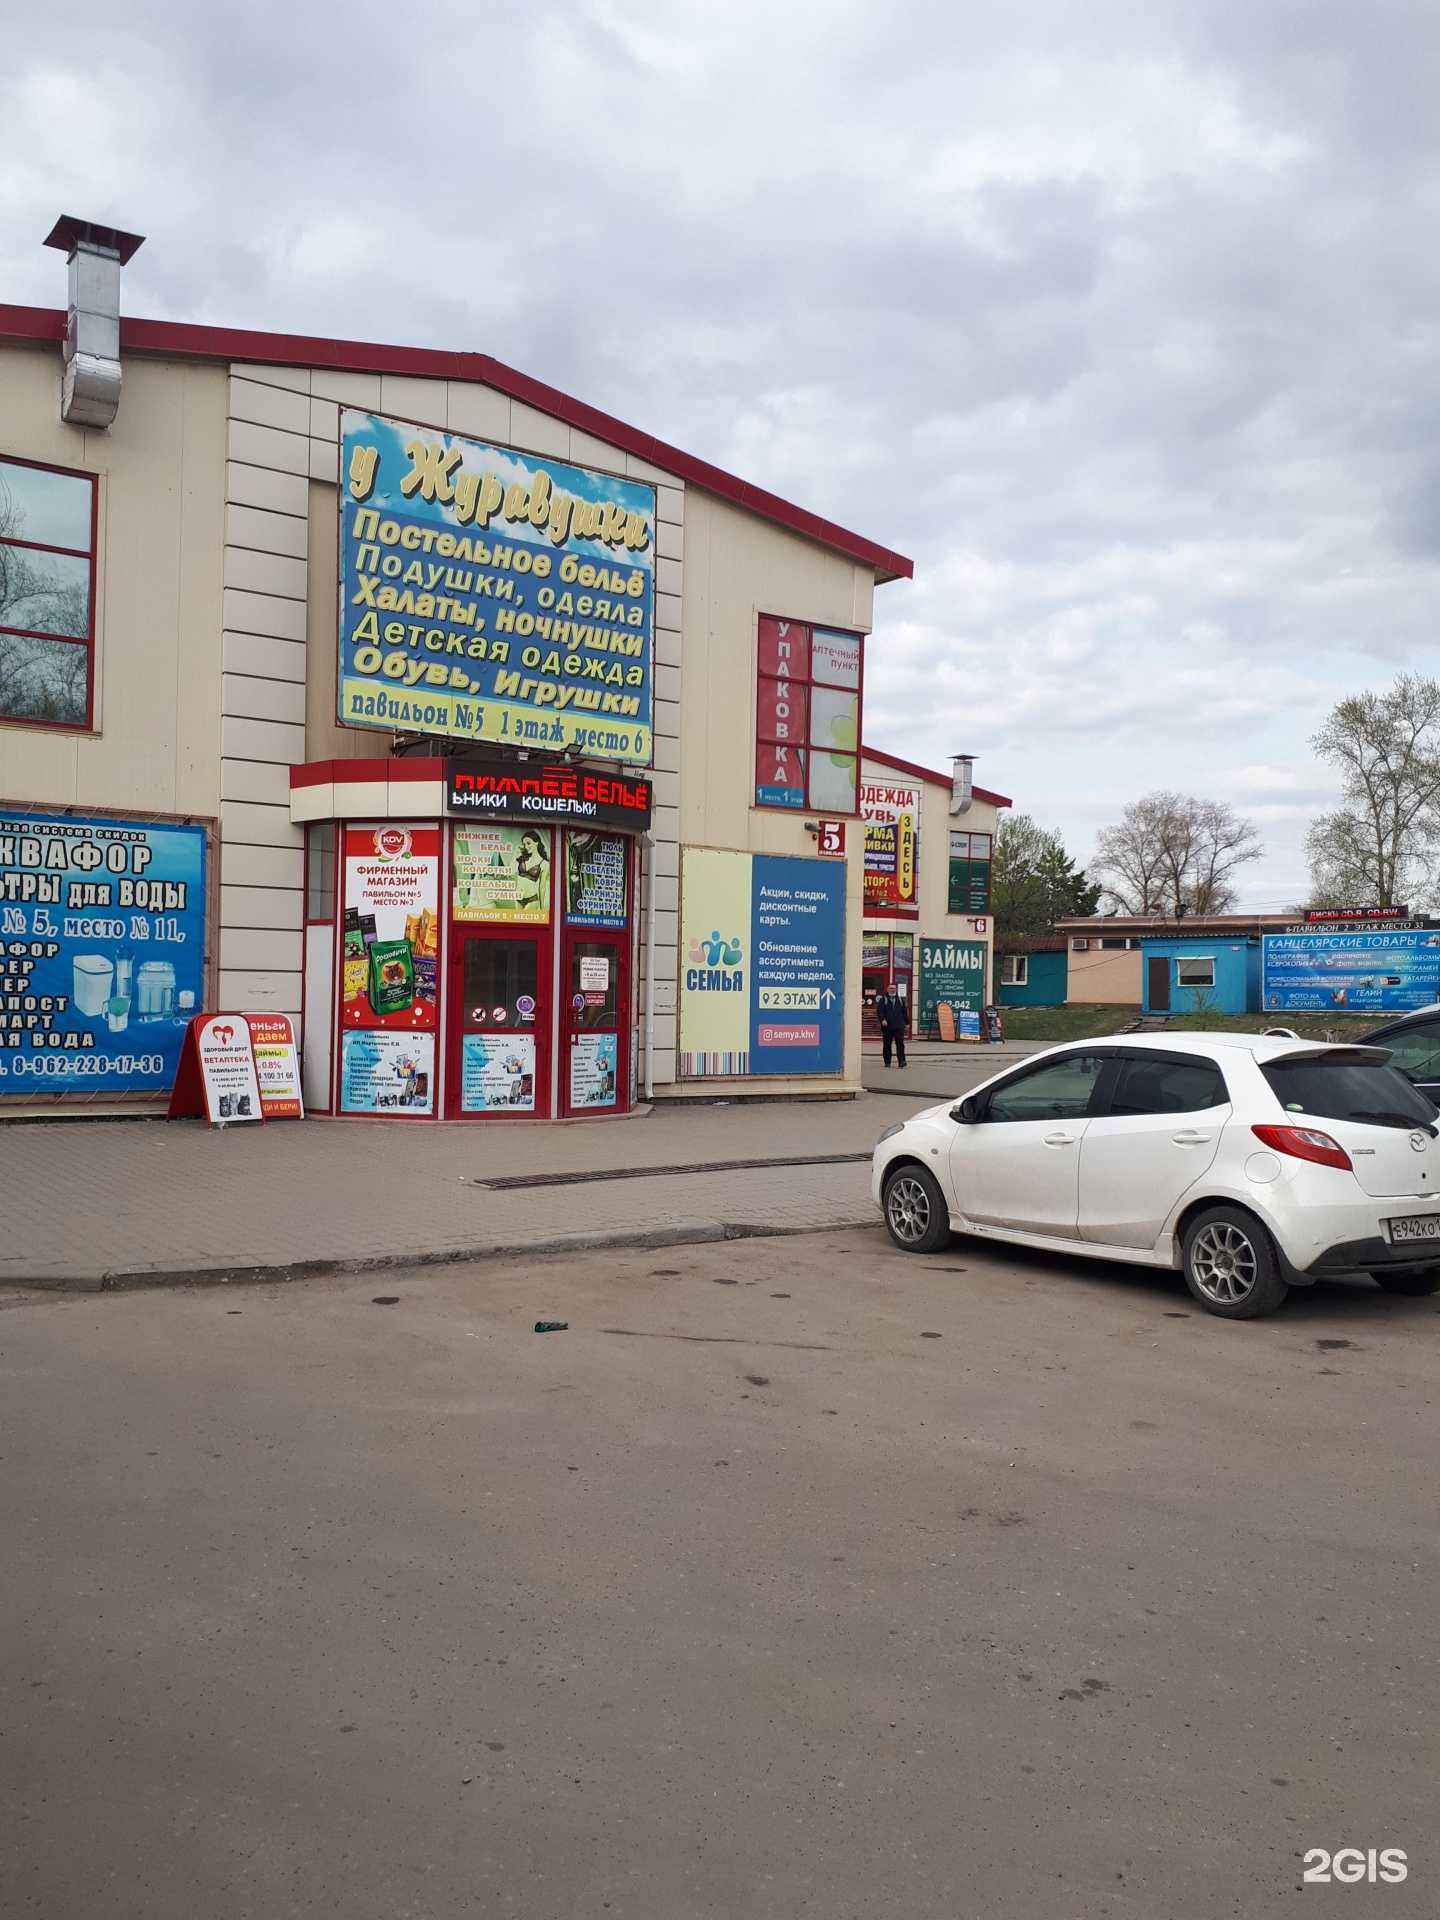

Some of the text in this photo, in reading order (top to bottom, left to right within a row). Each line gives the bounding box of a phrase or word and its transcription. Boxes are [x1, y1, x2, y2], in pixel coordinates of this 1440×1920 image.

[400, 440, 650, 547] Журавушки
[353, 507, 645, 599] Постельное бельё
[355, 543, 644, 628] Подушки, одеяла
[352, 574, 645, 657] Халаты, ночнушки
[352, 611, 644, 687] Детская одежда
[353, 646, 642, 718] Обувь, Игрушки
[774, 621, 792, 783] УПАКОВКА
[351, 692, 449, 727] павильон
[501, 710, 509, 736] 1
[514, 716, 565, 744] этаж
[574, 726, 630, 753] место
[634, 730, 644, 754] 6
[583, 775, 648, 810] БЕЛЬЁ
[521, 795, 598, 815] КОШЕЛЬКИ
[860, 807, 896, 823] УВЬ
[0, 821, 147, 842] кая система скидок
[456, 831, 501, 841] НИЖНЕЕ
[823, 823, 840, 850] 5
[601, 840, 624, 852] ТЮЛЬ
[902, 816, 911, 889] ЗДЕСЬ
[456, 855, 491, 863] НОСКИ
[593, 852, 624, 864] ШТОРЫ
[357, 864, 428, 875] ФИРМЕННЫЙ
[463, 865, 512, 874] КОЛГОТКИ
[581, 864, 624, 876] ГОБЕЛЕНЫ
[367, 877, 417, 886] МАГАЗИН
[458, 880, 515, 889] КОШЕЛЬКИ
[595, 877, 624, 888] КОВРЫ
[68, 881, 112, 909] для
[119, 878, 188, 914] ВОДЫ
[362, 890, 406, 898] ПАВИЛЬОН
[487, 891, 522, 899] СУМКИ
[584, 888, 624, 900] КАРНИЗЫ
[759, 885, 829, 901] Акции, скидки,
[577, 899, 624, 911] ФУРНИТУРА
[759, 901, 817, 913] дисконтные
[63, 916, 126, 939] место
[759, 914, 792, 927] карты.
[976, 918, 985, 932] 6
[1354, 923, 1379, 931] ЭТАЖ
[1381, 921, 1411, 931] МЕСТО
[759, 941, 818, 954] Обновление
[1268, 935, 1417, 949] КАНЦЕЛЯРСКИЕ ТОВАРЫ
[758, 956, 825, 969] ассортимента
[922, 944, 983, 970] ЗАЙМЫ
[0, 959, 36, 975] ЕР
[686, 968, 743, 992] СЕМЬЯ
[758, 970, 836, 982] каждую неделю.
[0, 996, 68, 1012] ПОСТ
[772, 992, 817, 1006] 2 ЭТАЖ
[250, 1022, 286, 1031] еньги
[32, 1032, 96, 1049] ВОДА
[256, 1032, 287, 1043] даем
[773, 1029, 816, 1041] semya.khv
[13, 1055, 165, 1076] 8-962-228-17-36
[204, 1056, 250, 1064] ВЕТАПТЕКА
